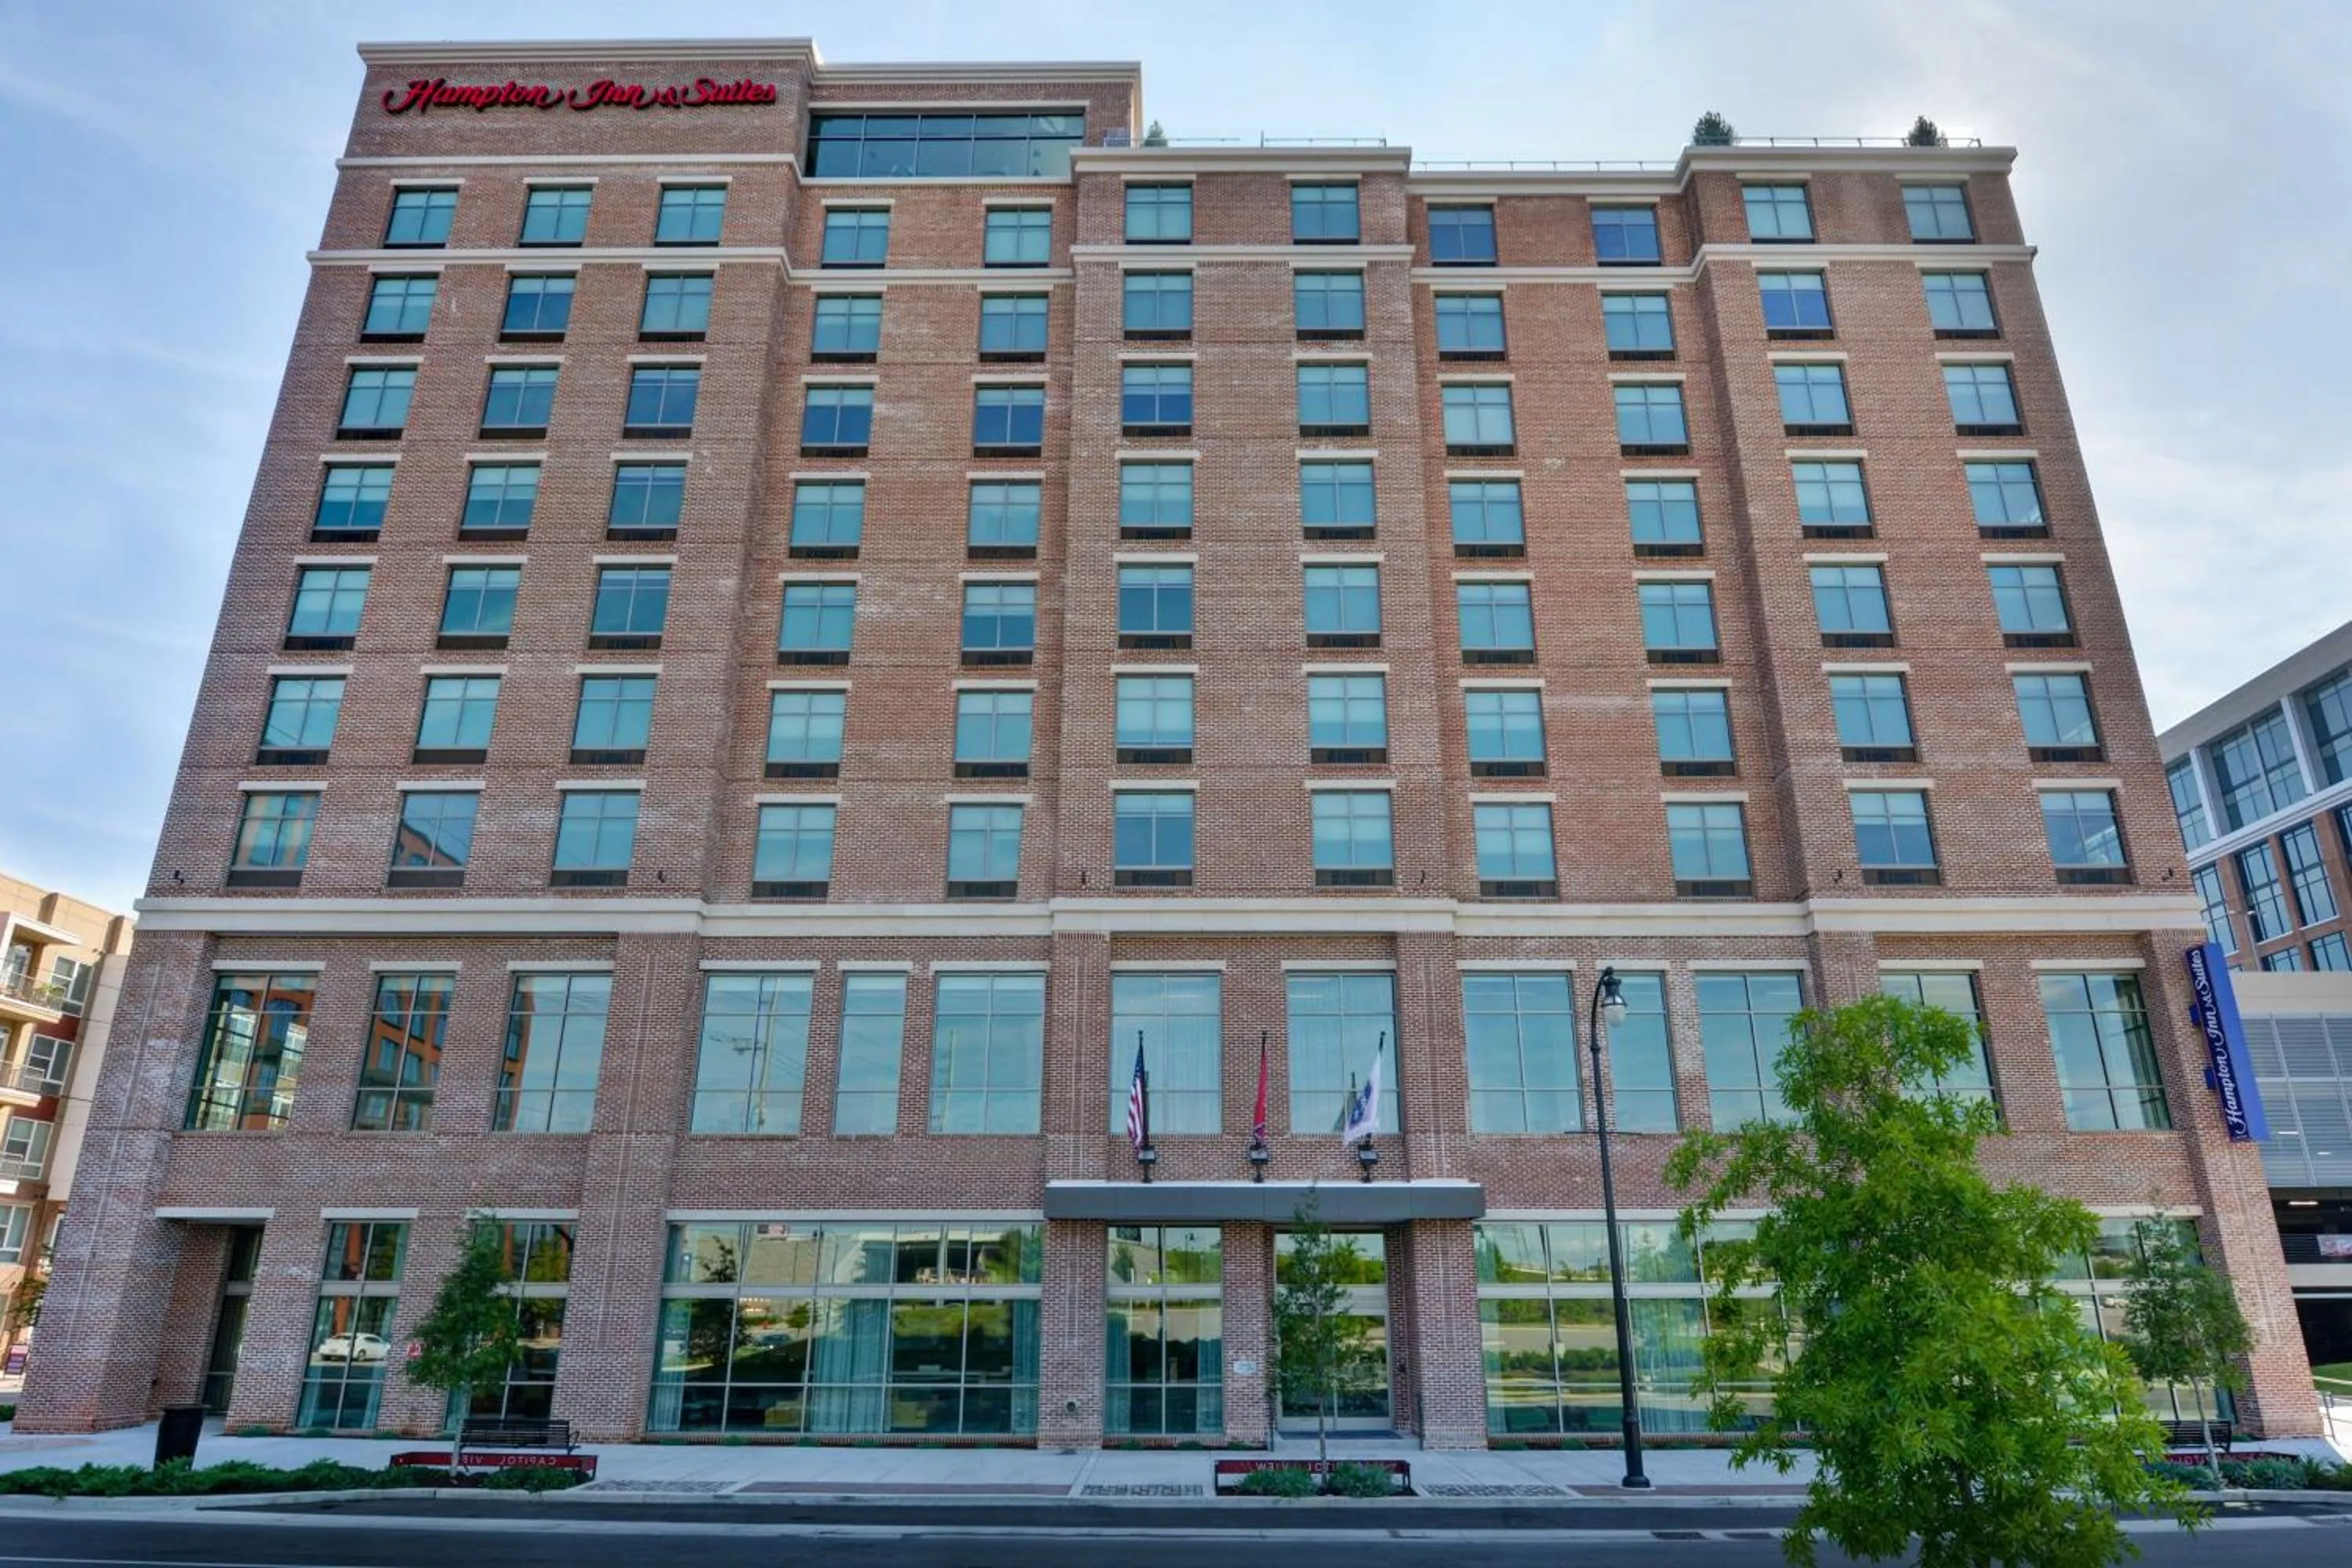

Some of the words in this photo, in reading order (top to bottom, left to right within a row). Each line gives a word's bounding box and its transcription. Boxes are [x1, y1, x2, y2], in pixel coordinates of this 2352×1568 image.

[381, 78, 564, 114] Hampton
[567, 79, 657, 110] Inn
[681, 76, 776, 107] Suites
[2191, 949, 2210, 995] Suites
[2205, 1004, 2224, 1046] Inn
[2215, 1047, 2246, 1134] Hampton
